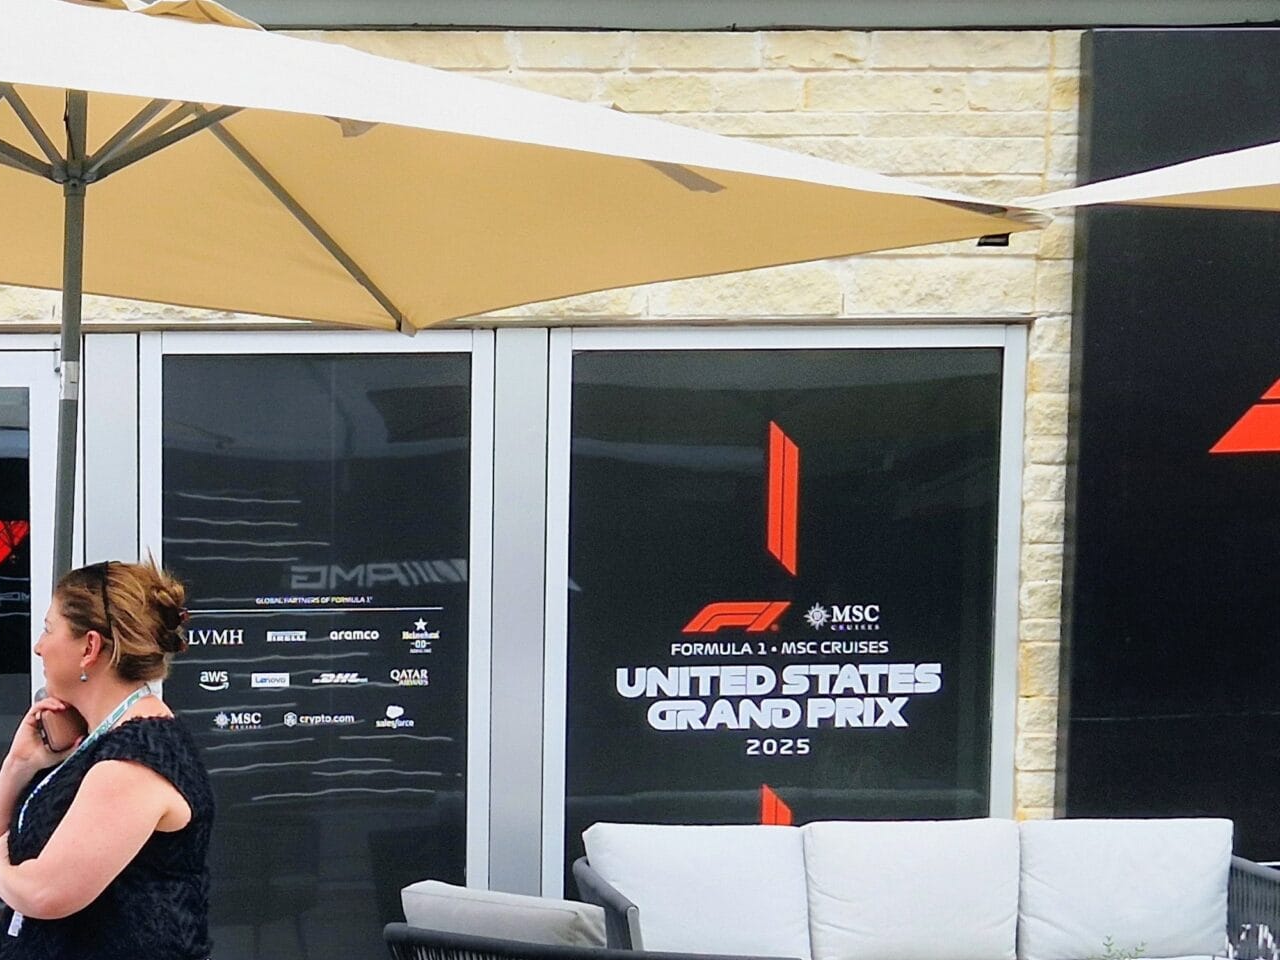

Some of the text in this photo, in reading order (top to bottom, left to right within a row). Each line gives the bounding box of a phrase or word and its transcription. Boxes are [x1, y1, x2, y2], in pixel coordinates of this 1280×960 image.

[255, 597, 283, 605] GLOBAL
[284, 597, 320, 605] PARTNERS
[331, 596, 365, 604] FORMULA
[682, 602, 880, 633] F1 MSC
[188, 629, 244, 645] LVMH
[329, 630, 380, 641] aramco
[671, 641, 889, 656] FORMULA 1 MSC CRUISES
[200, 669, 428, 684] aws Lenovo DHL QATAR
[616, 663, 942, 698] UNITED STATES
[230, 712, 262, 724] MSC
[299, 714, 355, 726] crypto.com
[647, 697, 909, 731] GRAND PRIX
[746, 738, 810, 755] 2025
